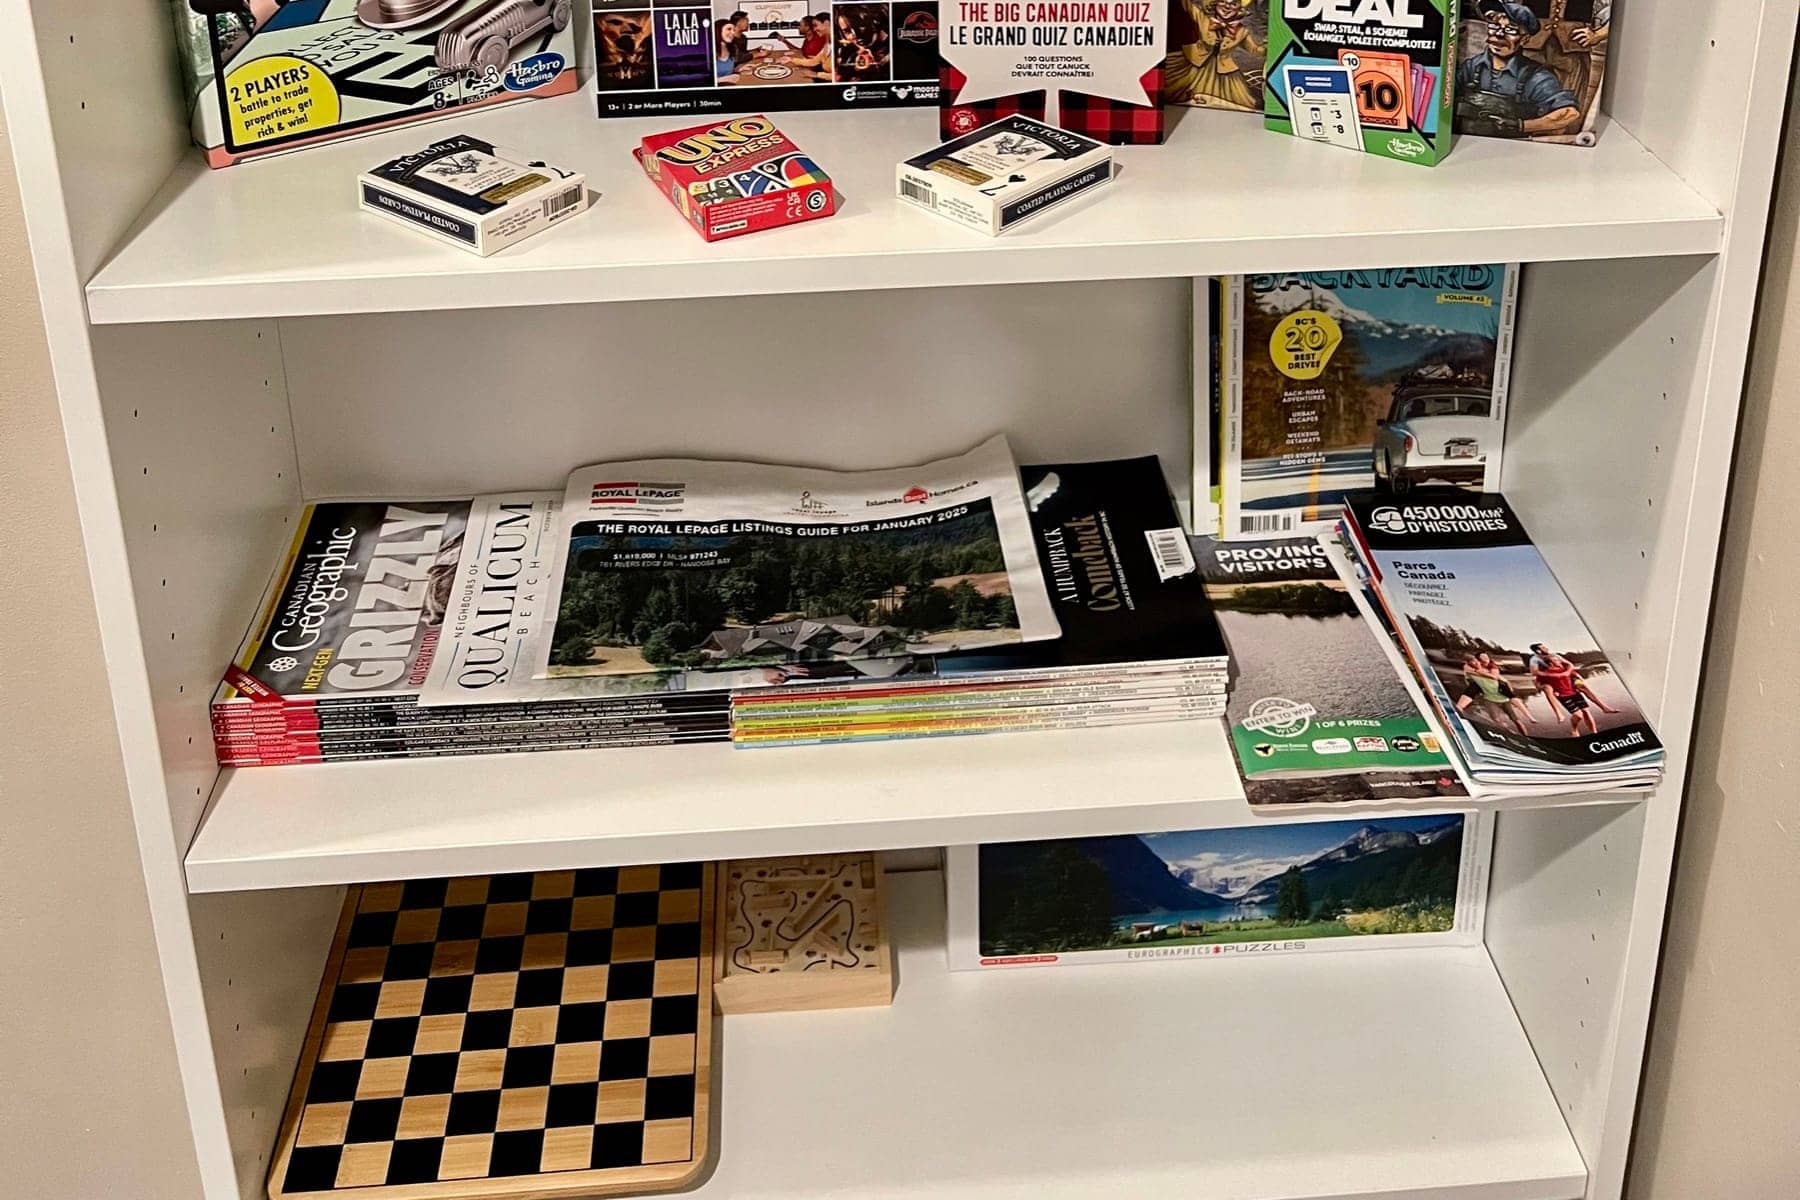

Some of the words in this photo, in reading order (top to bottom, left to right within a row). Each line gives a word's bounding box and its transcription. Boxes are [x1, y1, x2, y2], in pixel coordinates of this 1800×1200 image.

[664, 13, 680, 30] LA
[683, 13, 699, 29] LA
[960, 3, 988, 22] THE
[996, 3, 1021, 22] BIG
[1026, 3, 1108, 22] CANADIAN
[1114, 3, 1150, 22] QUIZ
[667, 29, 699, 46] LAND
[950, 27, 966, 46] LE
[974, 27, 1026, 46] GRAND
[1032, 27, 1067, 46] QUIZ
[1075, 27, 1153, 47] CANADIEN
[231, 87, 240, 102] 2
[245, 65, 310, 98] PLAYERS
[239, 96, 268, 114] battle
[270, 91, 282, 104] to
[284, 84, 310, 102] trade
[1359, 80, 1399, 112] 10
[244, 106, 294, 130] properties,
[297, 96, 313, 116] get
[256, 123, 275, 139] rich
[277, 120, 286, 133] &
[288, 114, 308, 129] win!
[656, 117, 776, 165] UNO
[1012, 121, 1080, 150] VICTORIA
[694, 134, 785, 175] EXPRESS
[1285, 327, 1328, 353] 20
[598, 524, 624, 534] THE
[628, 524, 672, 534] ROYAL
[676, 524, 728, 534] LEPAGE
[732, 522, 793, 535] LISTINGS
[797, 525, 839, 536] GUIDE
[843, 524, 869, 534] FOR
[873, 517, 933, 532] JANUARY
[938, 506, 968, 520] 2025
[1406, 518, 1508, 534] D'HISTOIRES
[1044, 527, 1076, 592] HUMPBACK
[1063, 514, 1120, 611] Comeback
[1219, 558, 1327, 574] VISITOR'S
[272, 527, 356, 651] Geographic
[281, 561, 317, 626] CANADIAN
[327, 505, 449, 691] GRIZZLY
[457, 502, 533, 689] QUALICUM
[517, 561, 541, 634] BEACH
[301, 648, 334, 691] NEXT-GEN
[408, 629, 440, 686] CONSERVATION
[1589, 731, 1645, 756] Canada
[1223, 941, 1305, 954] PUZZLES
